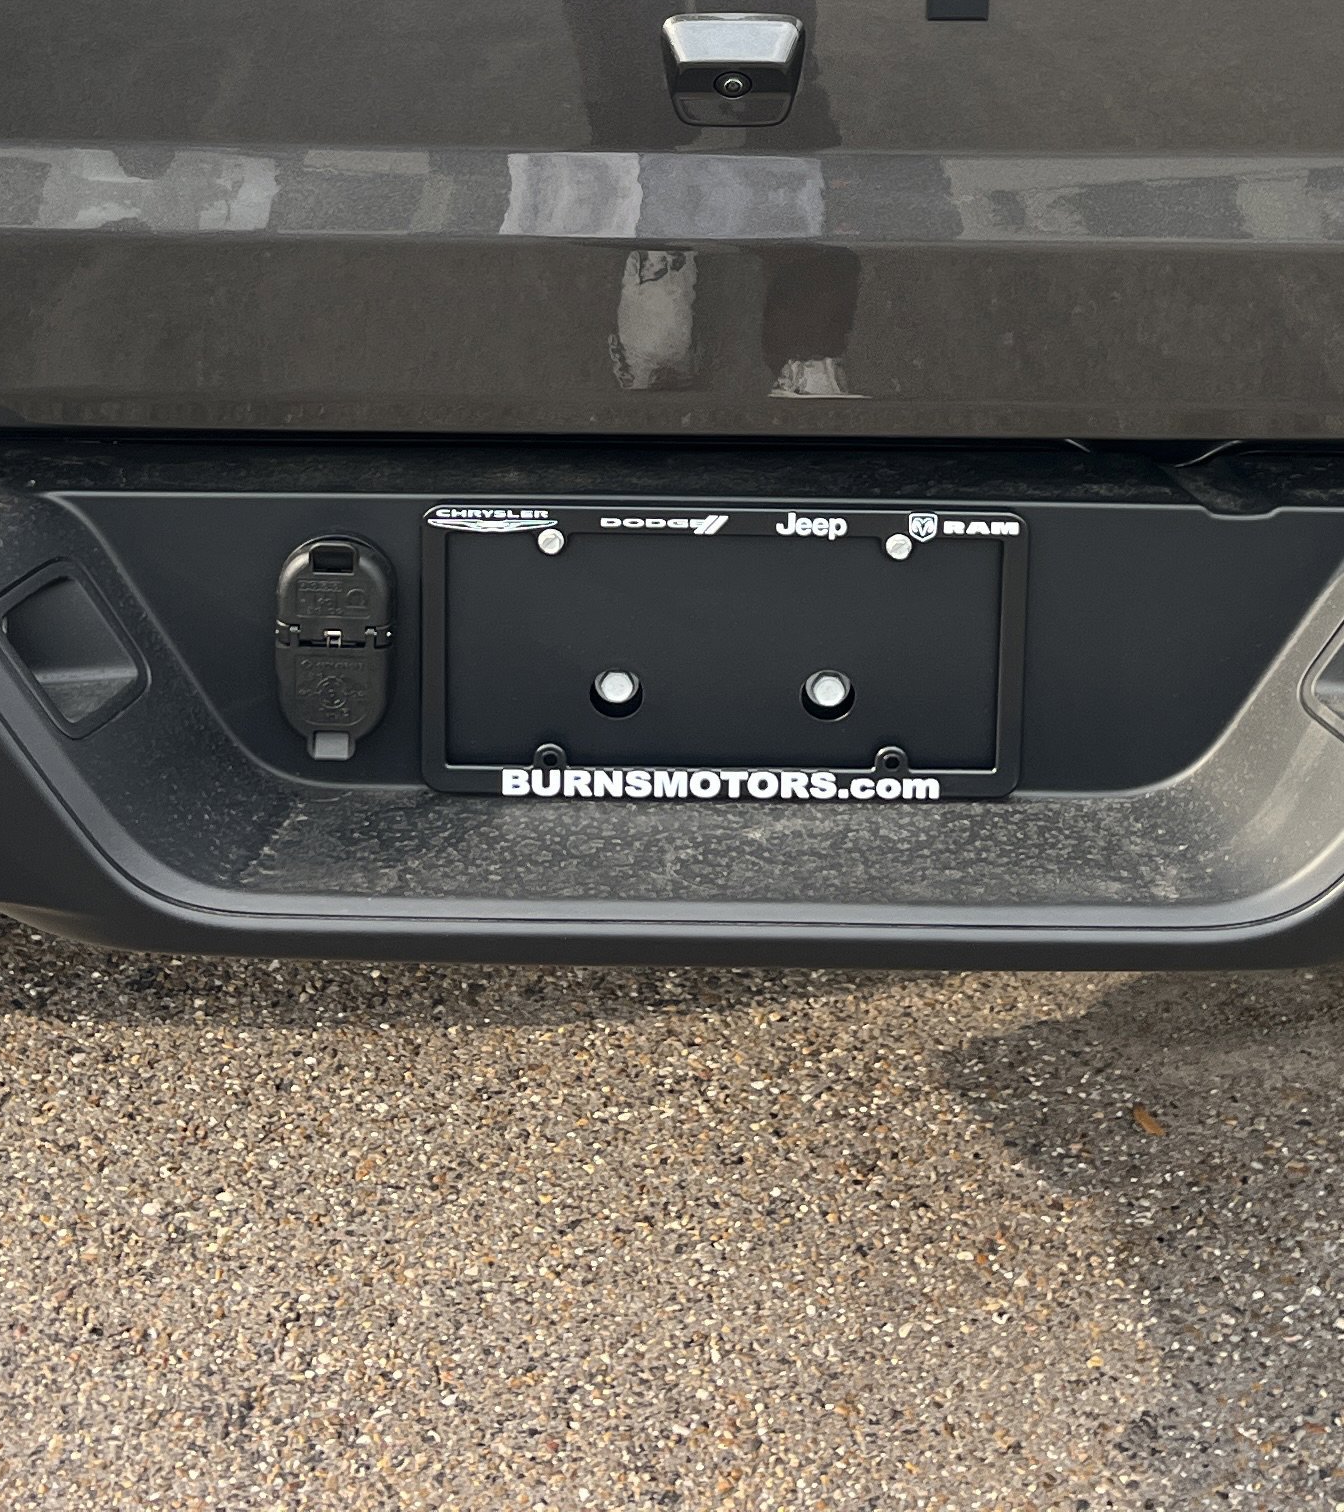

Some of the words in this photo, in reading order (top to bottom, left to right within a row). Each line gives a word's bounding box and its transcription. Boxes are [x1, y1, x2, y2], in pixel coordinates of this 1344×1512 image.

[435, 508, 549, 519] CHRYSLER
[599, 516, 708, 529] DODGE
[775, 511, 848, 541] Jeep
[942, 520, 1020, 536] RAM
[501, 768, 940, 800] BURNSMOTORS.com
